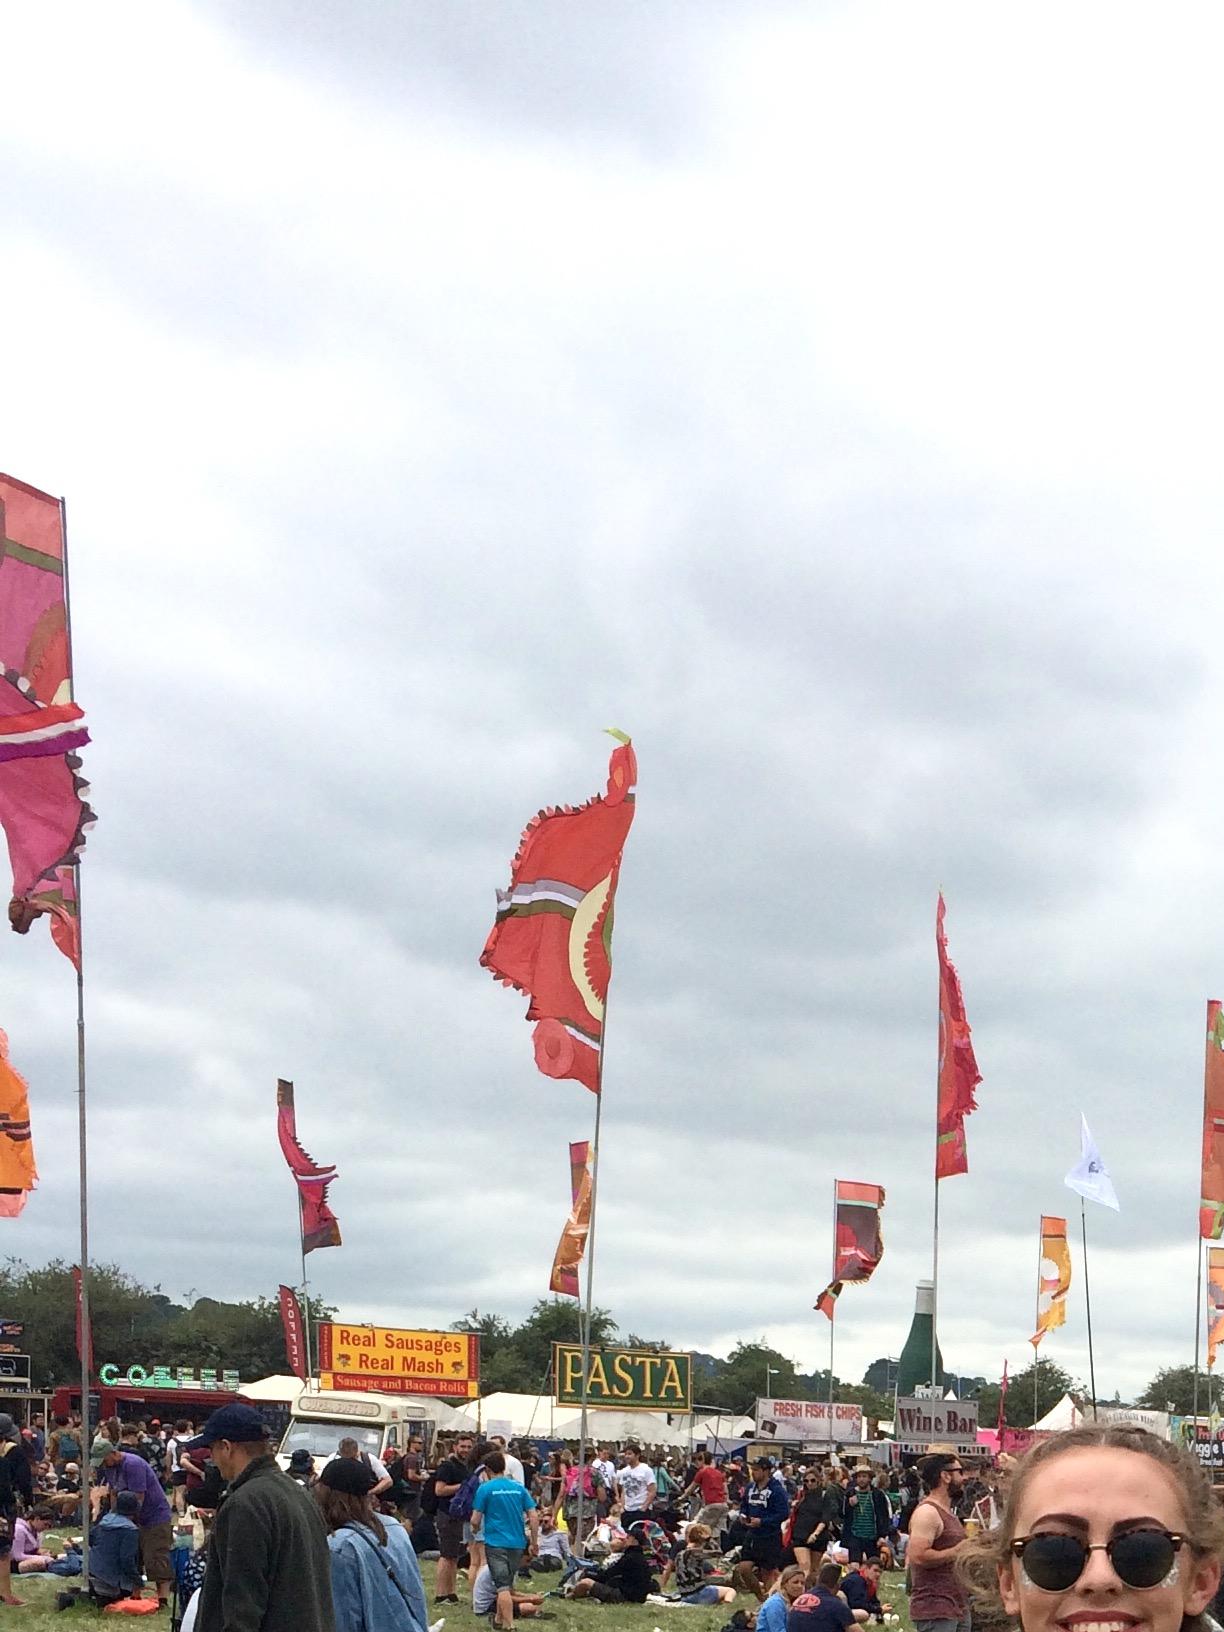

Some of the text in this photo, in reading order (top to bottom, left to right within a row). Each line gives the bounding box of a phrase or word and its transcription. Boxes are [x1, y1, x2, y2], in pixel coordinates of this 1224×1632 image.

[340, 1329, 376, 1347] Real
[384, 1333, 462, 1356] Sausages
[358, 1353, 444, 1374] Real Mash
[563, 1351, 685, 1398] PASTA
[99, 1363, 239, 1391] COFFEE
[336, 1375, 466, 1393] Sausage and Bacon Rolls
[773, 1401, 803, 1417] FRESH
[805, 1403, 825, 1419] FISH
[835, 1405, 861, 1421] CHIPS
[899, 1406, 977, 1434] Wine Bar
[1186, 1440, 1219, 1457] Vgge
